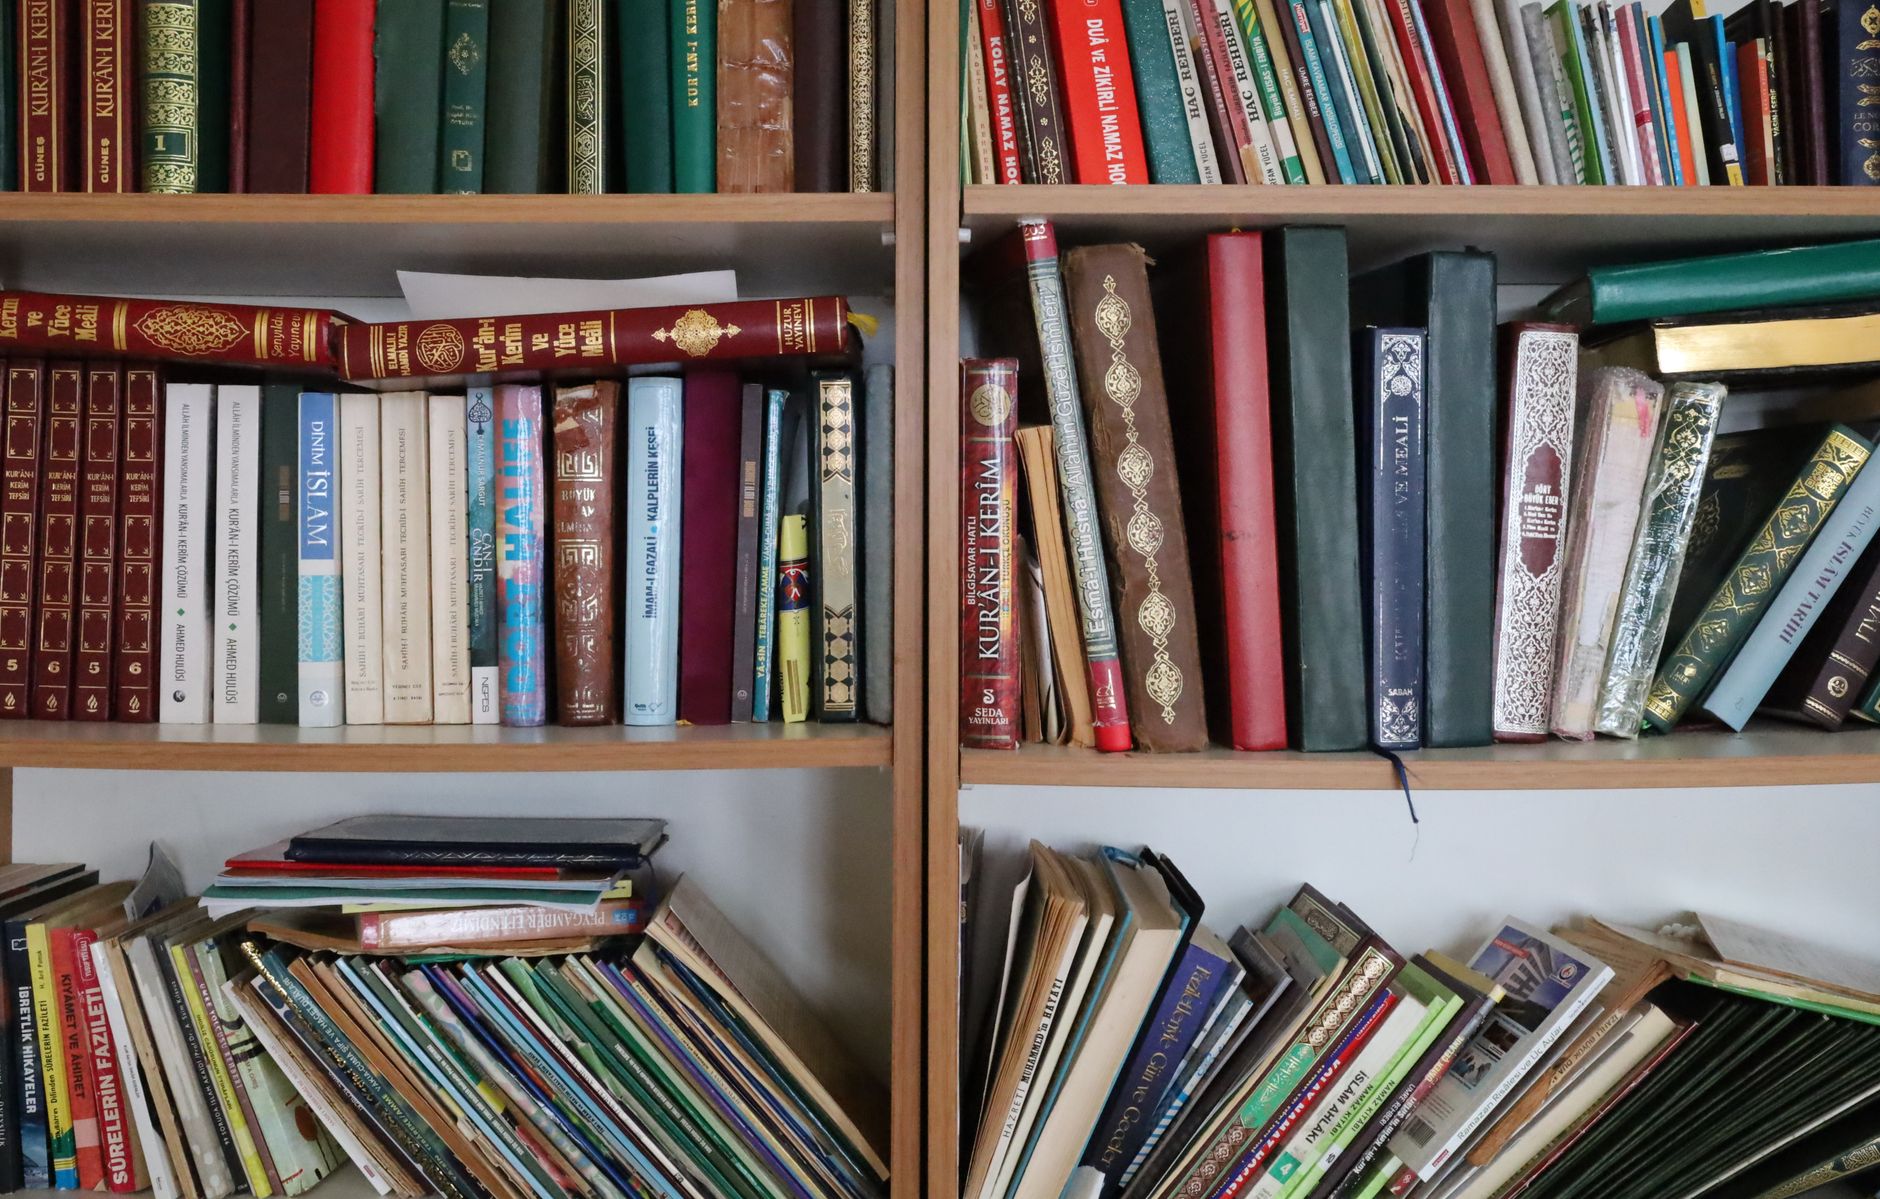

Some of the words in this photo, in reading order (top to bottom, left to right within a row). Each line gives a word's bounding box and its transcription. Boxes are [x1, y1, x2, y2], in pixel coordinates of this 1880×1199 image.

[1294, 3, 1309, 33] Hürriyet
[990, 36, 1007, 87] KOLAY
[1092, 49, 1106, 63] VE
[1093, 66, 1120, 111] ZİKİRLİ
[1182, 86, 1201, 119] HAC
[997, 94, 1016, 151] NAMAZ
[1242, 90, 1259, 122] HAC
[155, 135, 166, 151] 1
[1100, 114, 1124, 161] NAMAZ
[1199, 141, 1209, 164] YÜCEL
[35, 136, 46, 181] GÜNEŞ
[99, 138, 111, 183] GÜNEŞ
[1260, 144, 1271, 166] YÜCEL
[27, 311, 43, 327] ve
[48, 304, 71, 337] Yüce
[74, 304, 99, 341] Meâli
[784, 308, 799, 346] HUZUR
[794, 303, 811, 351] YAYINEVİ
[532, 333, 549, 351] ve
[553, 323, 576, 358] Yüce
[581, 319, 604, 357] Meâli
[1053, 367, 1074, 417] Güzel
[311, 421, 326, 466] DİNİM
[1392, 415, 1409, 477] MEALİ
[477, 475, 487, 507] SARGUT
[645, 460, 659, 522] KALPLERİN
[967, 516, 977, 542] HATLI
[1071, 501, 1095, 562] Hüsnâ
[967, 543, 977, 606] BİLGİSAYAR
[176, 624, 185, 652] AHMED
[226, 638, 237, 671] AHMED
[7, 659, 18, 671] 5
[48, 661, 60, 673] 6
[89, 662, 100, 674] 5
[129, 662, 142, 674] 6
[1387, 688, 1414, 697] SABAH
[968, 717, 1009, 725] YAYINLARI
[975, 707, 1003, 718] SEDA
[18, 985, 33, 1042] İBRETLİK
[40, 1000, 49, 1031] FAZİLETİ
[85, 986, 113, 1070] FAZİLETİ
[197, 981, 213, 1008] UMRE
[207, 1009, 229, 1049] YOLCUSU
[69, 1033, 80, 1050] VE
[324, 1026, 336, 1038] VE
[1001, 1087, 1027, 1138] HAZRETİ
[1041, 977, 1064, 1018] HAYATI
[1140, 1049, 1169, 1085] Gün
[1556, 1058, 1574, 1075] DUA
[22, 1043, 37, 1115] HİKAYELER
[47, 1074, 58, 1104] Dilinden
[1131, 1082, 1149, 1103] ve
[1398, 1082, 1415, 1102] UMRE
[1455, 1098, 1494, 1140] Ramazan
[1519, 1058, 1532, 1072] ve
[1539, 1024, 1564, 1049] Aylar
[97, 1074, 128, 1185] SÛRELERİN
[212, 1106, 227, 1135] SORUDA
[1374, 1116, 1401, 1147] Kerim'in
